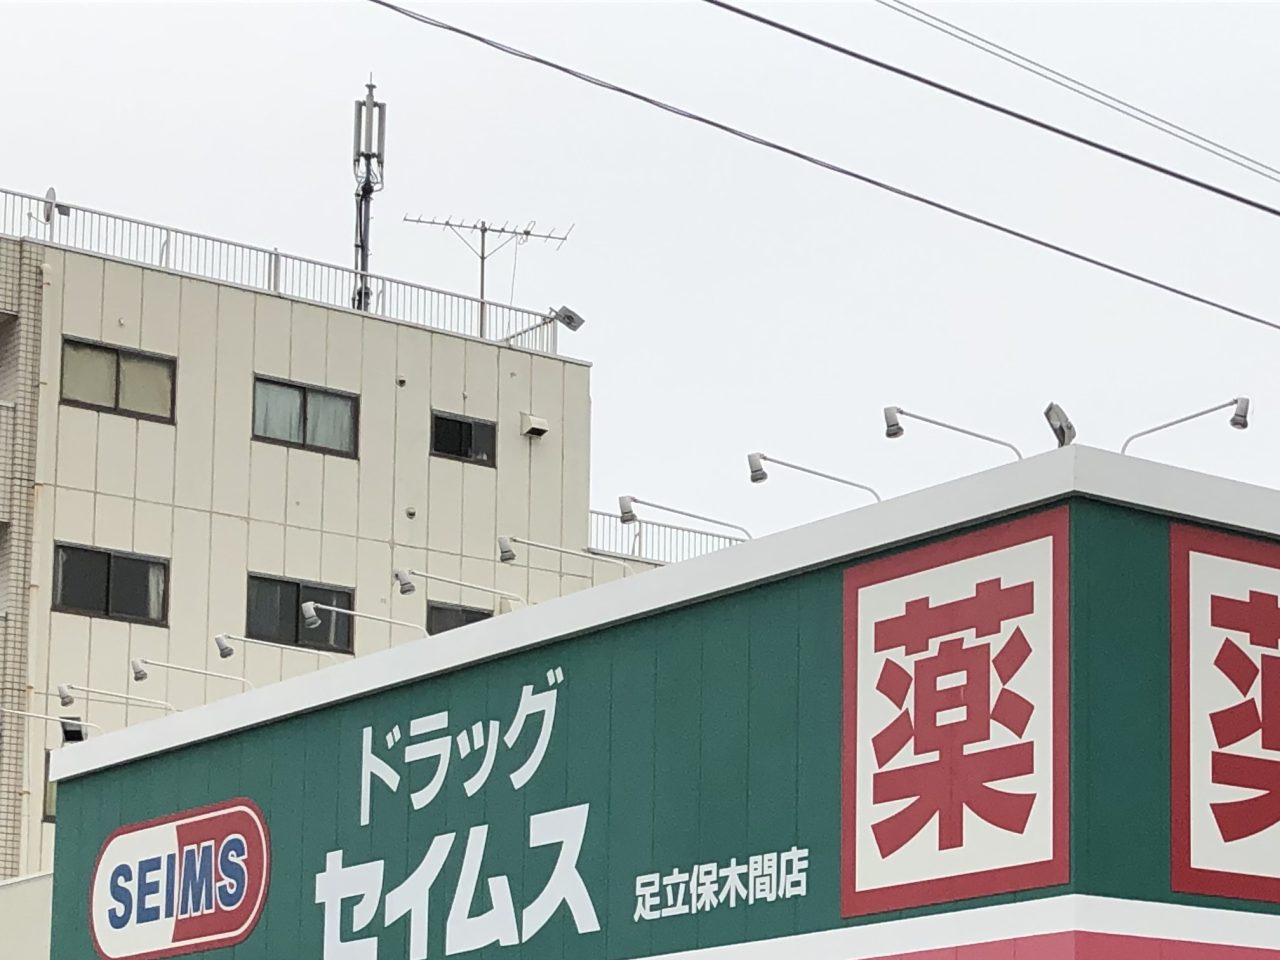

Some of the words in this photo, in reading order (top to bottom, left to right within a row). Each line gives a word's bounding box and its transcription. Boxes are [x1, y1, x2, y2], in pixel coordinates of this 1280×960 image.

[360, 666, 564, 826] ドラッグ
[871, 577, 1037, 859] 薬
[107, 833, 248, 929] SEIMS
[633, 846, 809, 922] 足立保木間店
